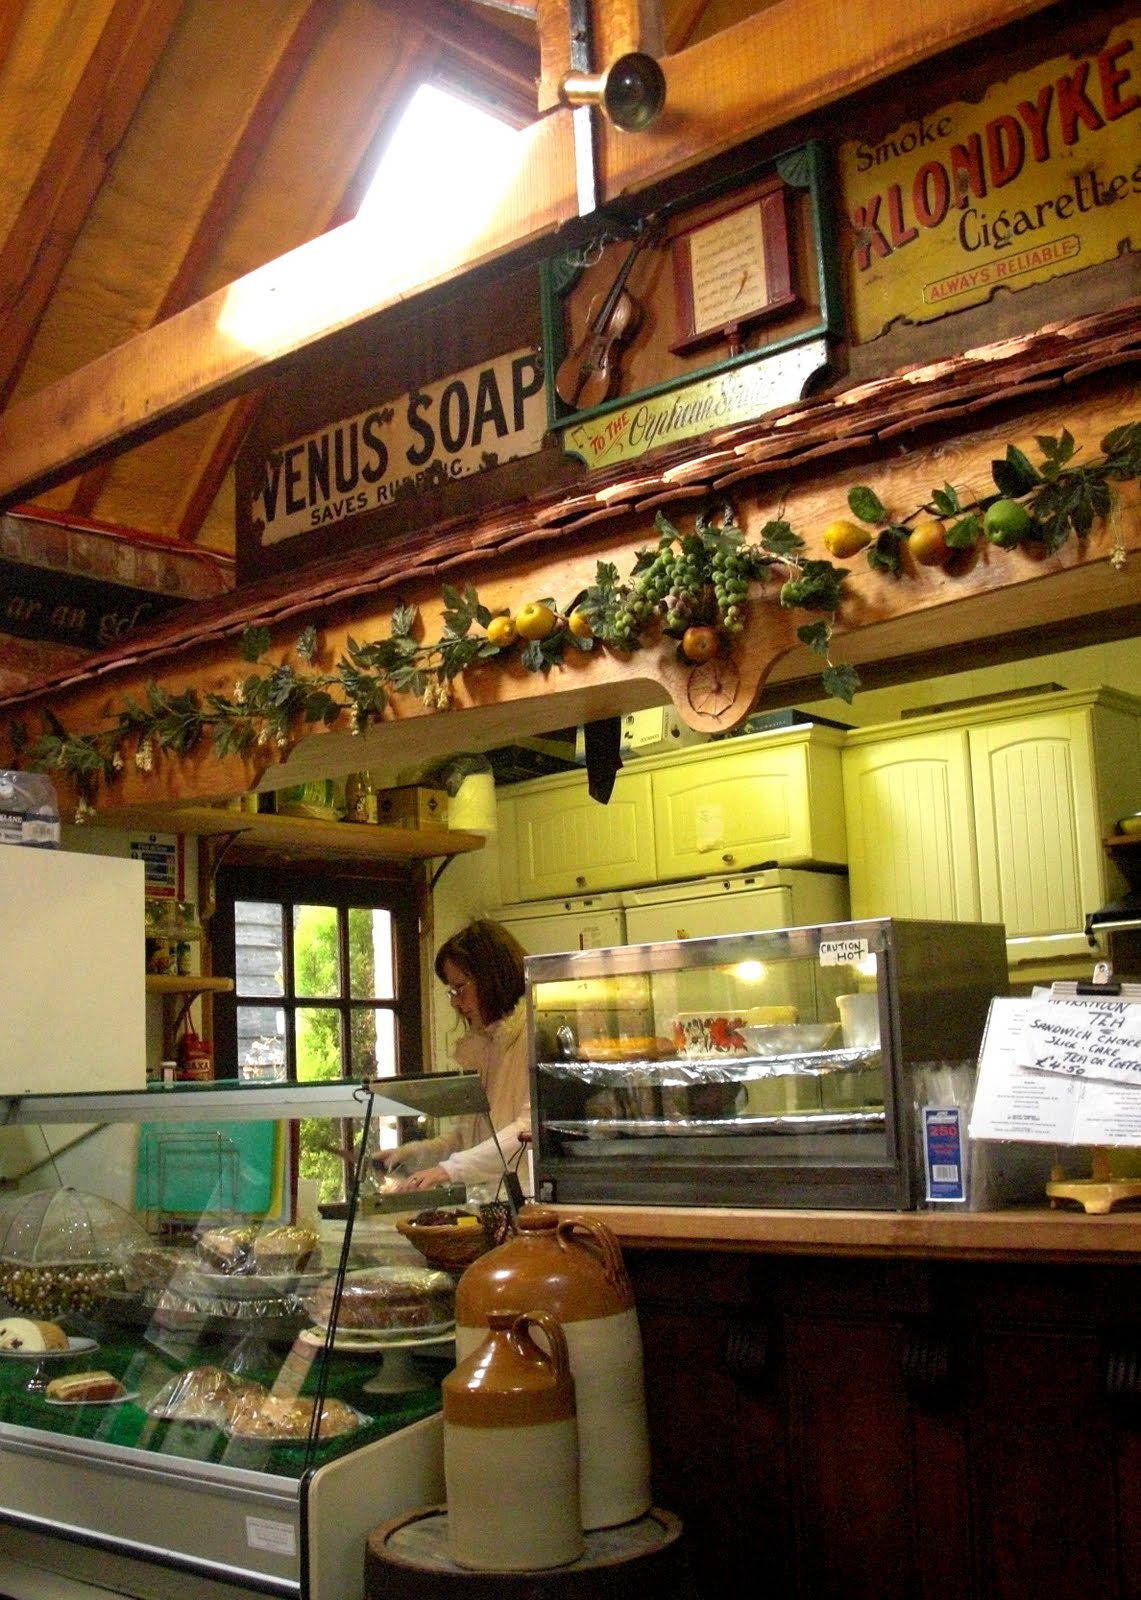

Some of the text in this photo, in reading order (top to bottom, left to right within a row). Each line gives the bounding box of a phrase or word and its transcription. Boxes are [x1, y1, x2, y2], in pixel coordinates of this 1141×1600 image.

[851, 39, 1141, 272] KLONDYKE
[855, 114, 952, 172] Smoke
[958, 162, 1141, 252] Cigarettes
[929, 268, 990, 301] ALWAYS
[405, 355, 545, 467] SOAP
[590, 434, 606, 455] TO
[605, 411, 630, 441] THE
[310, 492, 368, 527] SAVES
[821, 941, 861, 953] CAUTION
[837, 950, 865, 961] HOT
[1089, 1012, 1126, 1028] TEA
[1035, 1055, 1086, 1075] £4.50
[1063, 1051, 1088, 1064] TEA
[1089, 1044, 1120, 1057] CAKE
